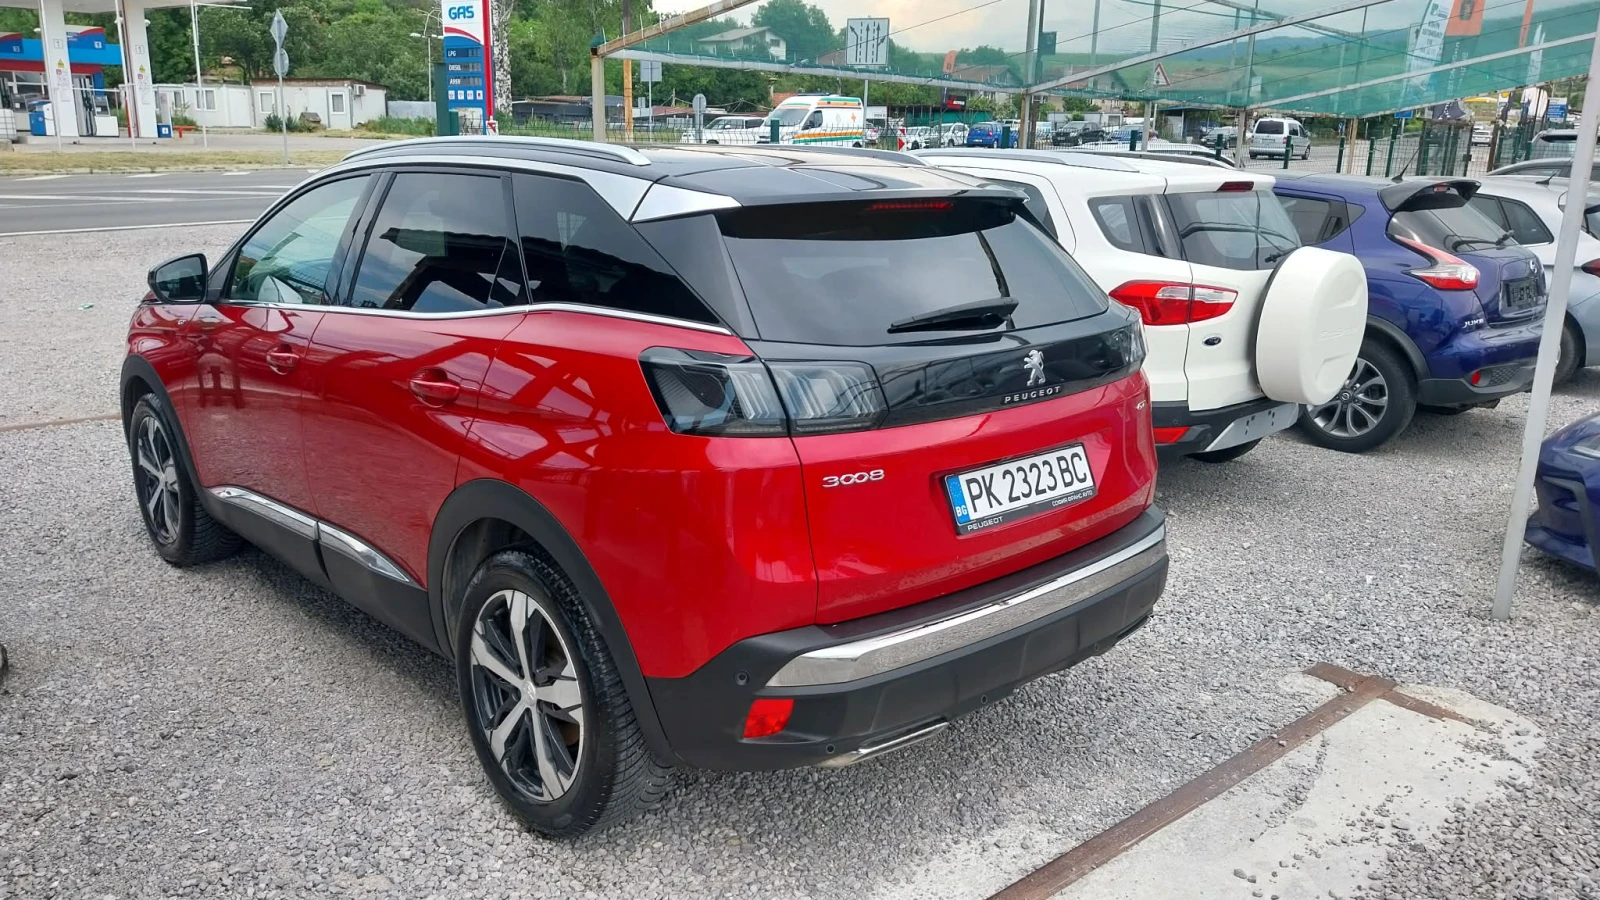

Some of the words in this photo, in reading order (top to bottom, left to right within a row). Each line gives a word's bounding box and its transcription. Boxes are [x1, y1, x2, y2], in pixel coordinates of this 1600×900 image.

[448, 5, 475, 20] GAS
[1004, 385, 1062, 404] PEUGEOT
[822, 469, 885, 488] 3008
[965, 473, 1003, 513] PK
[1002, 459, 1058, 503] 2323
[1056, 452, 1087, 488] BC
[956, 505, 968, 517] BG
[967, 516, 1004, 532] PEUGEOT
